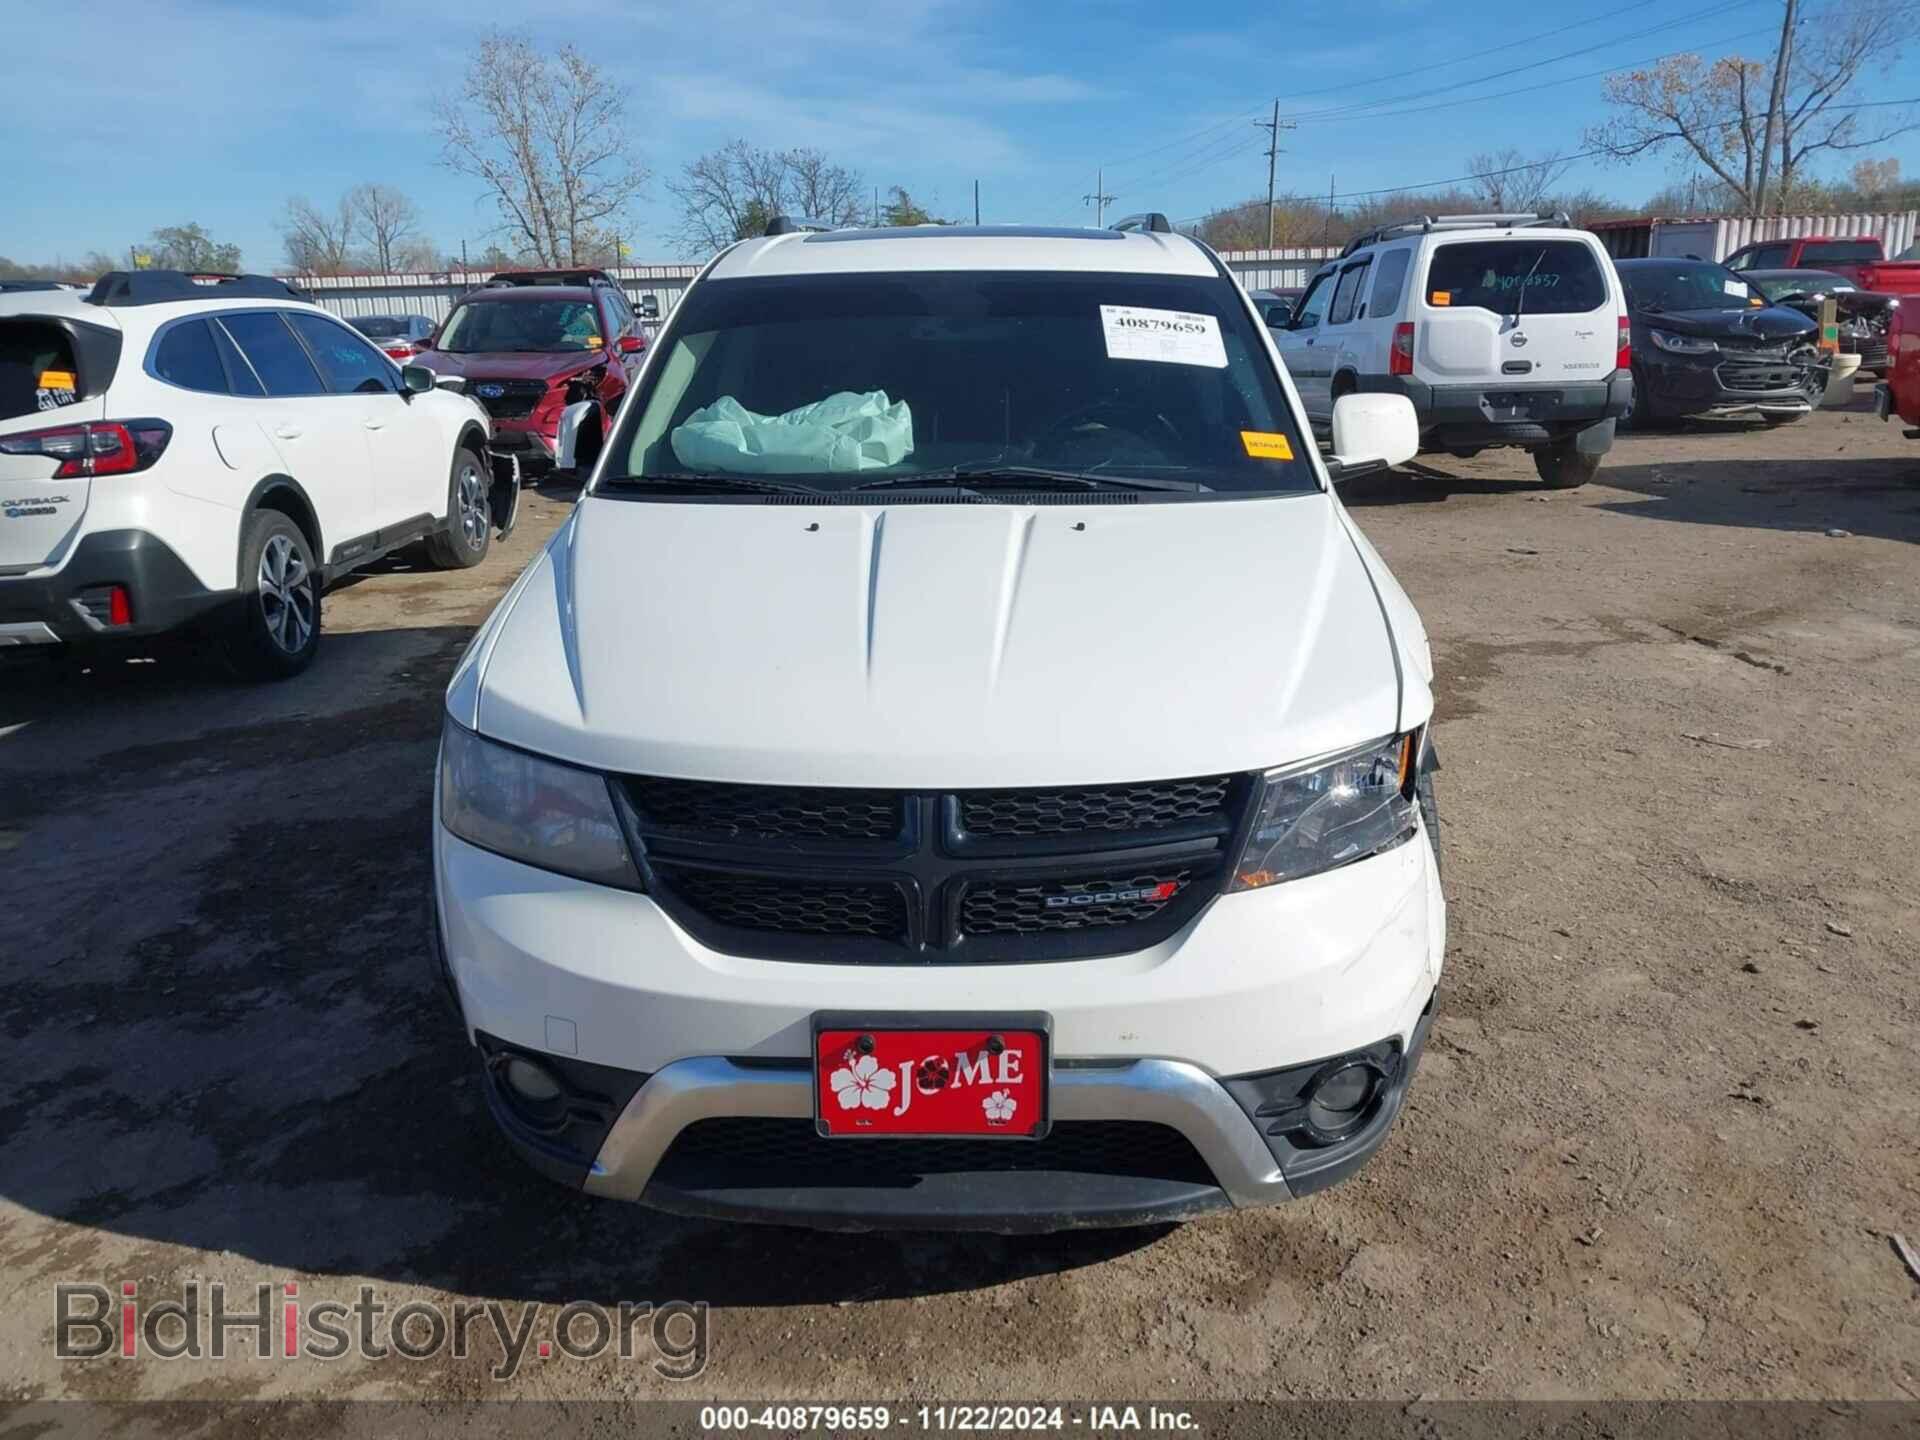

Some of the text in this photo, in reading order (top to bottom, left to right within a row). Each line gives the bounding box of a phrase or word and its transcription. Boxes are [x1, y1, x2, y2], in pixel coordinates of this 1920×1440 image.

[1115, 318, 1206, 334] 40879659
[1, 495, 70, 507] OUTBACK
[1047, 889, 1160, 906] DODGE
